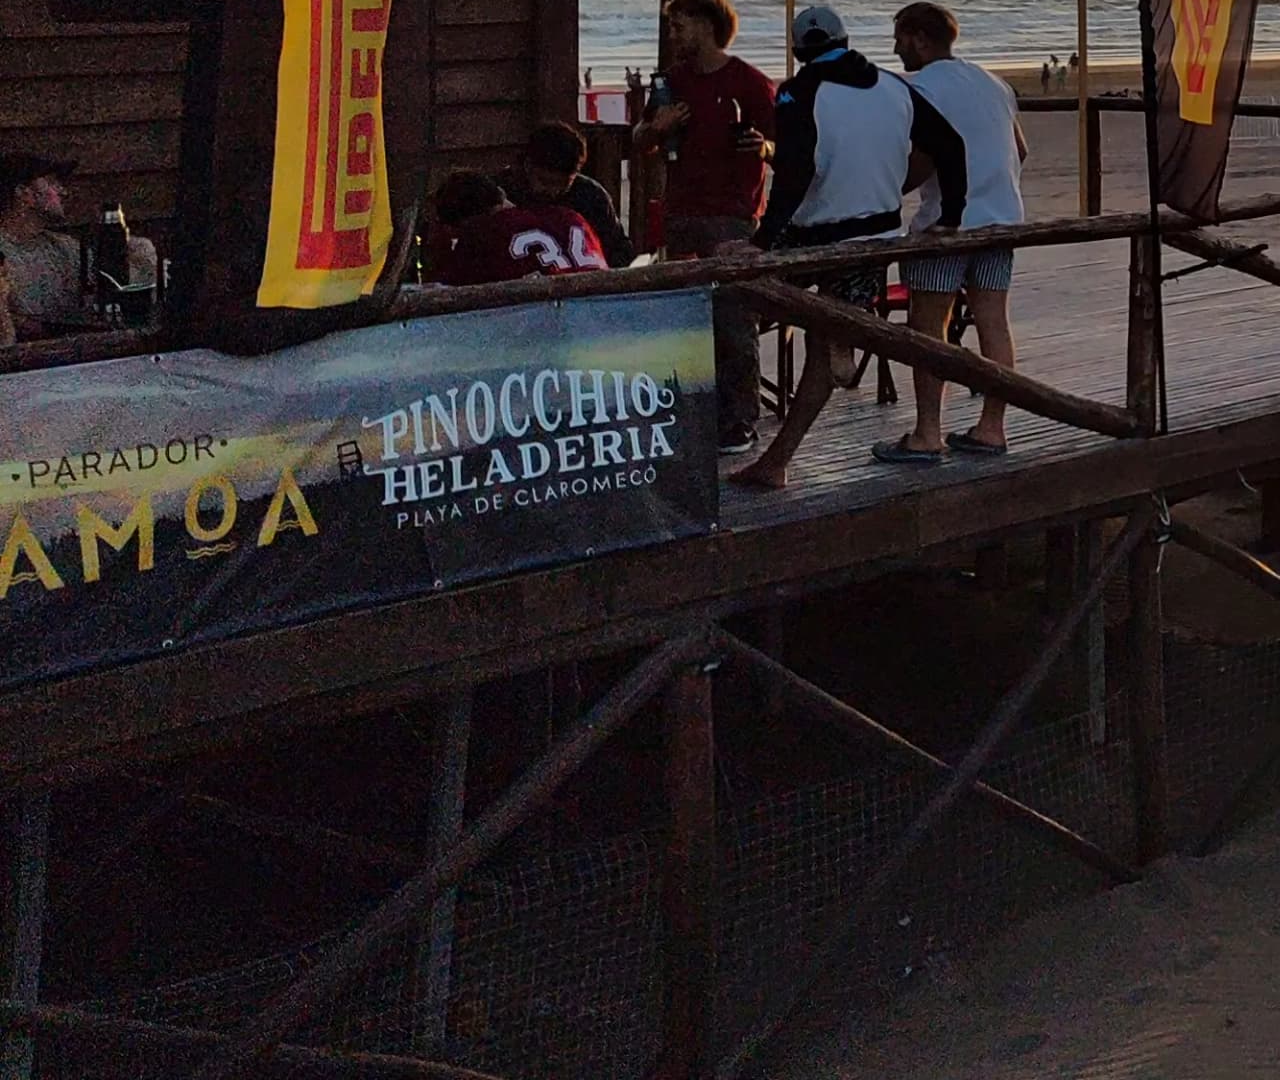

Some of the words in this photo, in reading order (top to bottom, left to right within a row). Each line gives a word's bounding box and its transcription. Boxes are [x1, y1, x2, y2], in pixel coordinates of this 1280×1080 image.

[362, 368, 675, 461] PINOCCHIO
[28, 433, 215, 488] PARADOR
[363, 413, 676, 506] HELADERIA
[397, 506, 462, 530] PLAYA
[475, 491, 504, 515] DE
